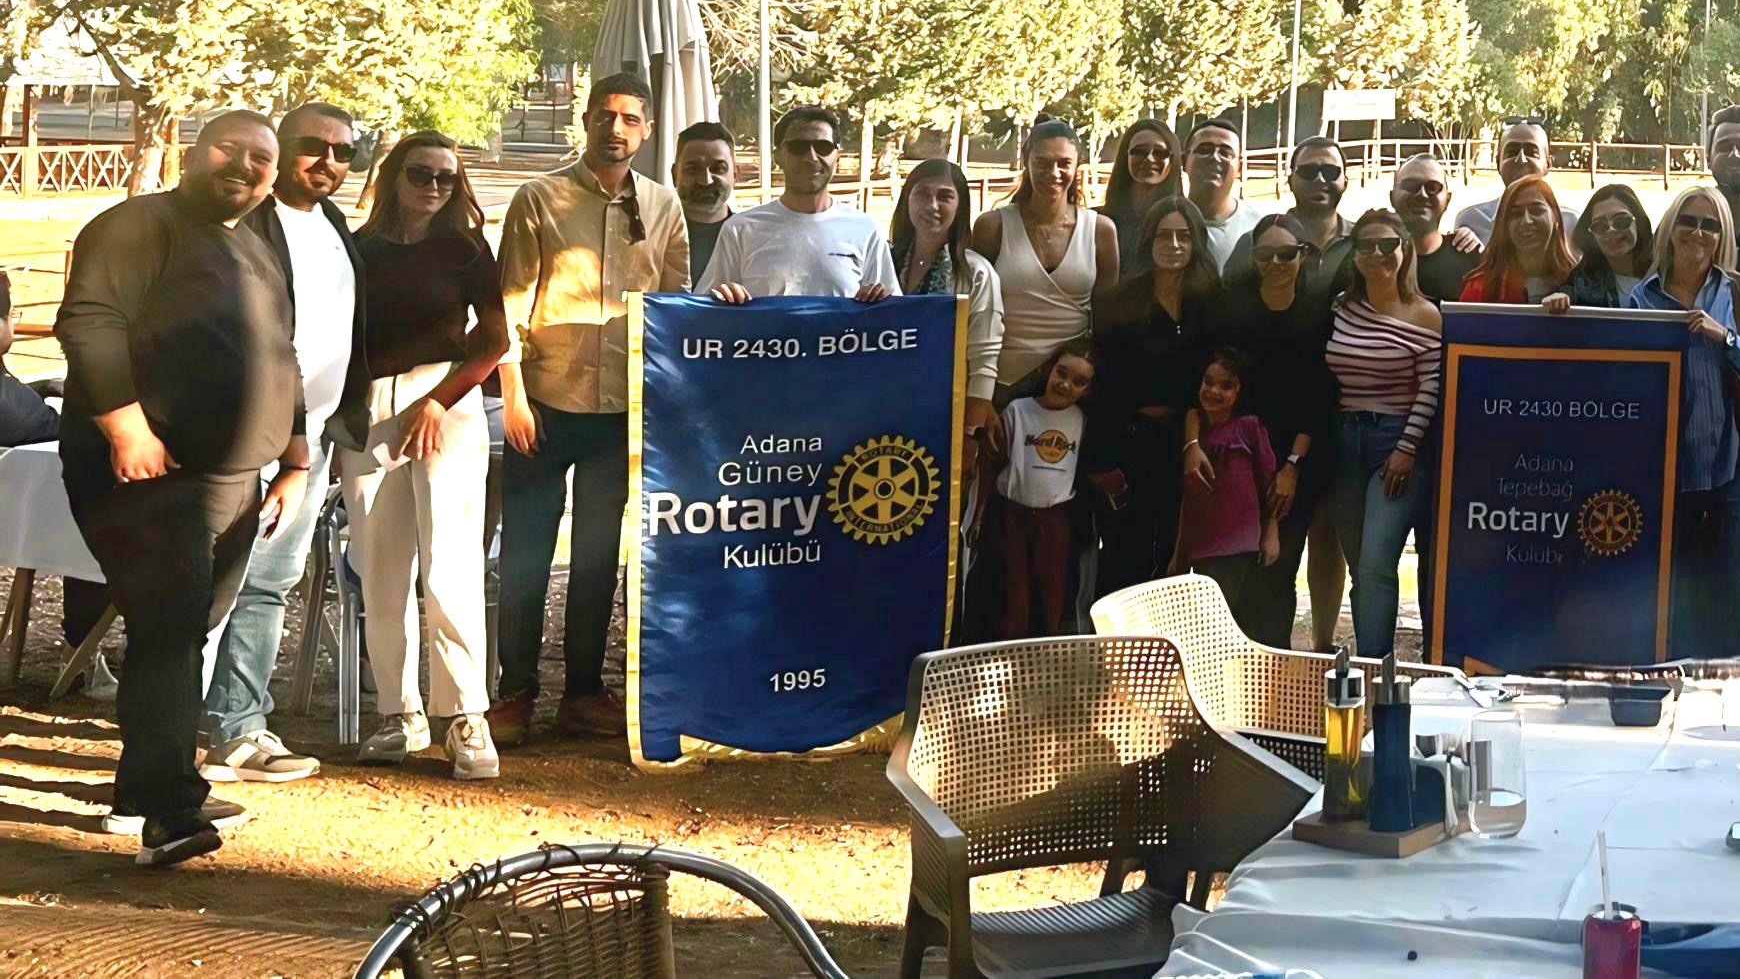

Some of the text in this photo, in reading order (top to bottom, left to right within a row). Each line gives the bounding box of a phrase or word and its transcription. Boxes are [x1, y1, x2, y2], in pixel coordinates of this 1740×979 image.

[683, 328, 918, 359] UR 2430. BÖLGE
[1484, 399, 1513, 415] UR
[1519, 400, 1563, 417] 2430
[741, 434, 822, 455] Adana
[718, 462, 822, 486] Güney
[1514, 453, 1574, 472] Adana
[648, 491, 822, 537] Rotary
[1467, 502, 1570, 538] Rotary
[723, 540, 821, 569] Kulübü
[769, 669, 827, 693] 1995
